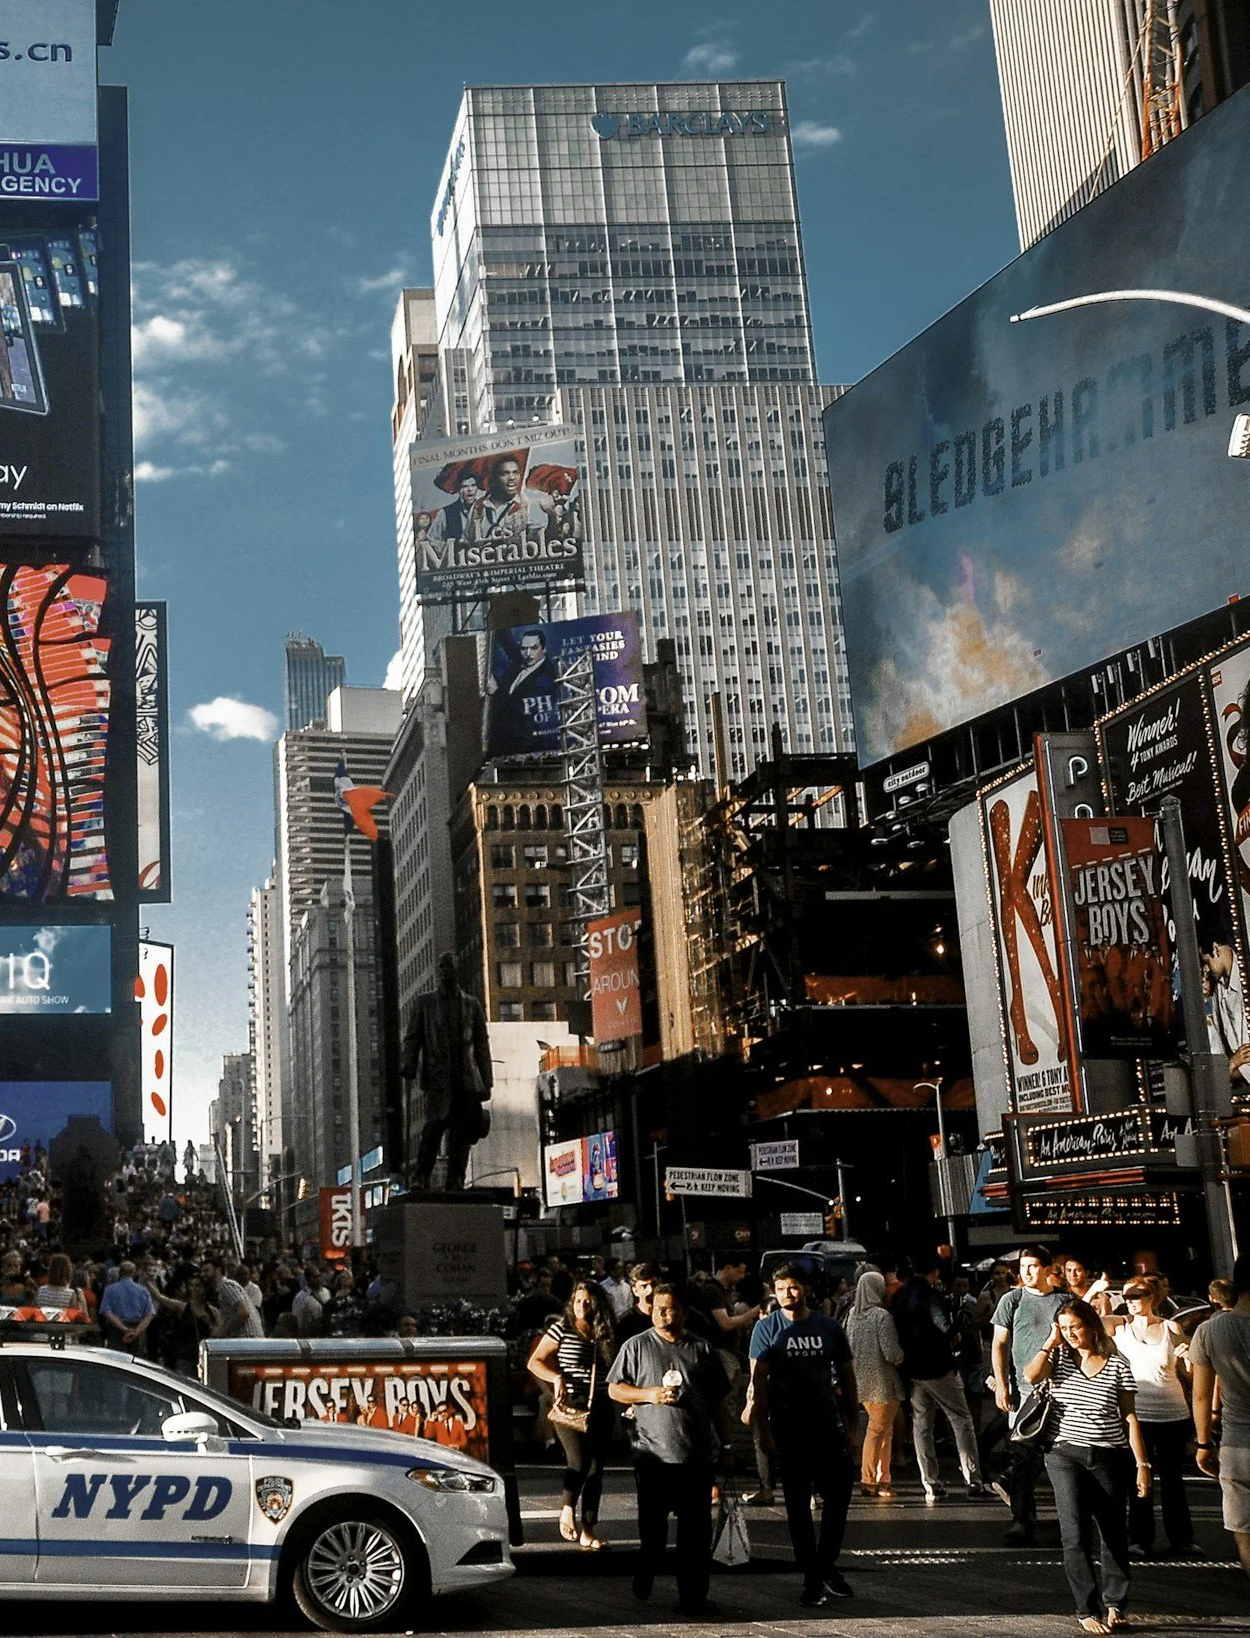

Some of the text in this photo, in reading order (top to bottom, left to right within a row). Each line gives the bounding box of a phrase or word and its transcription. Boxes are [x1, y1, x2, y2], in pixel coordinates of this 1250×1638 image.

[627, 112, 768, 136] BARCLAYS
[414, 454, 440, 467] FINAL
[443, 445, 488, 462] MONTHS
[525, 433, 543, 444] MIZ
[12, 502, 46, 511] Schmidt
[58, 503, 84, 511] Netflix
[475, 523, 514, 542] Les
[419, 527, 578, 572] Misérables
[489, 566, 527, 577] IMPERIAL
[528, 562, 564, 573] THEATRE
[591, 630, 625, 644] YOUR
[1127, 698, 1181, 753] Winner!
[1130, 733, 1179, 773] 4 TONY AWARDS
[901, 766, 926, 781] outdoor
[1127, 750, 1198, 806] Best Musical!
[1074, 853, 1155, 906] JERSEY
[1088, 899, 1150, 946] BOYS
[15, 995, 40, 1004] AUTO
[41, 995, 69, 1004] SHOW
[1046, 1067, 1062, 1087] TONY
[1044, 1086, 1061, 1099] BEST
[701, 1183, 740, 1193] KEEP MOVING
[786, 1335, 823, 1351] ANU
[786, 1348, 825, 1357] SPORT
[253, 1375, 476, 1431] JERSEY BOYS
[51, 1473, 233, 1521] NYPD
